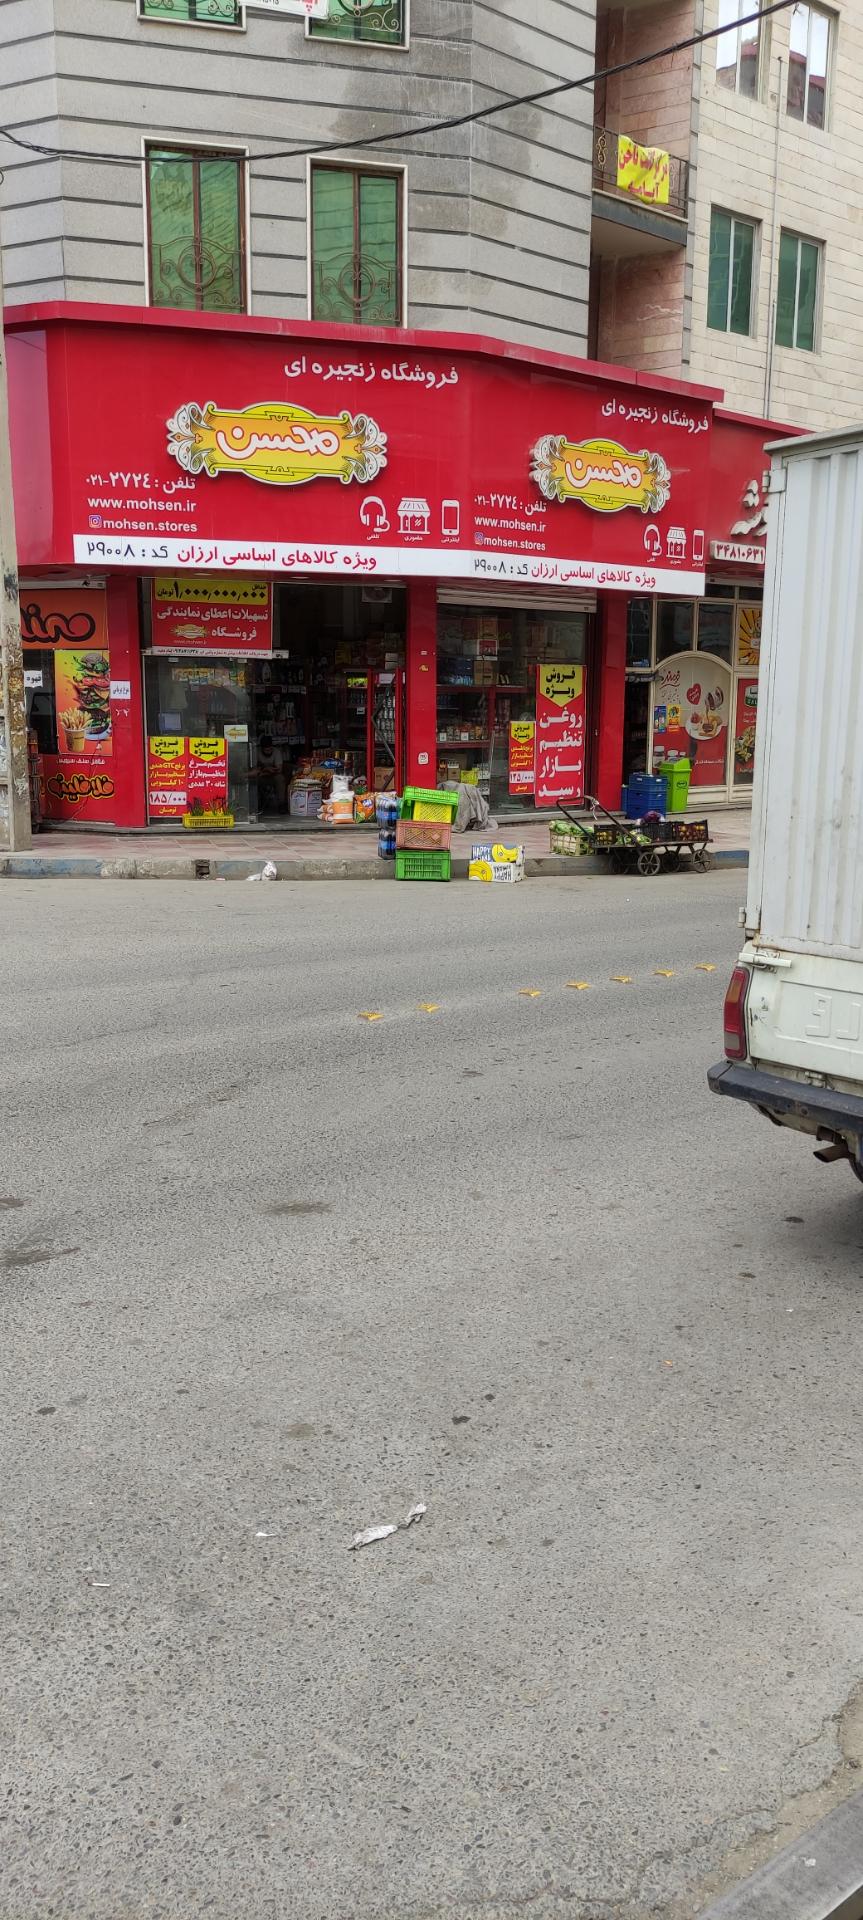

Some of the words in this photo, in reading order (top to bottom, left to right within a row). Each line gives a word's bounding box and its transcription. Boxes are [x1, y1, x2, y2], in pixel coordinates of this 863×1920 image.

[284, 356, 307, 377] ای
[311, 361, 376, 382] زنجیره
[380, 361, 459, 389] فروشگاه
[601, 398, 616, 417] ای
[618, 406, 659, 425] زنجیره
[662, 412, 709, 433] فروشگاه
[216, 425, 340, 460] محسن
[565, 457, 642, 488] محسن
[87, 497, 196, 512] www.mohsen.ir
[103, 518, 198, 532] mohsen.stores
[474, 515, 546, 532] www.mohsen.ir
[87, 541, 135, 557] ۲۹۰۰۸
[484, 536, 546, 551] mohsen.stores
[177, 545, 217, 562] ارزان
[222, 547, 275, 565] اساسی
[281, 549, 338, 566] کالاهای
[343, 552, 377, 570] ویژه
[716, 544, 764, 562] ۳۴۸۱۰۶۳۱
[474, 558, 507, 575] ۲۹۰۰۸
[531, 562, 558, 578] ارزان
[560, 566, 594, 581] اساسی
[597, 568, 633, 584] کالاهای
[635, 571, 656, 588] ویژه
[157, 588, 174, 597] تومان
[156, 605, 201, 619] نمایندگی
[201, 607, 232, 621] اعطای
[232, 608, 269, 622] تسهیلات
[211, 626, 257, 641] فروشگاه
[545, 667, 576, 683] فروش
[545, 685, 575, 698] ویژه
[539, 707, 582, 729] روغن
[155, 739, 179, 748] فروش
[194, 740, 218, 749] فروش
[539, 729, 583, 753] تنظیم
[155, 748, 178, 756] ویژه
[194, 749, 218, 757] ویژه
[189, 758, 207, 768] مرغ
[207, 760, 226, 768] تخم
[539, 755, 582, 778] بازار
[188, 769, 203, 778] بازار
[202, 770, 225, 778] تنظیم
[150, 793, 186, 803] ۱۸۵/۰۰۰
[538, 783, 581, 799] رسید
[159, 806, 177, 814] تومان
